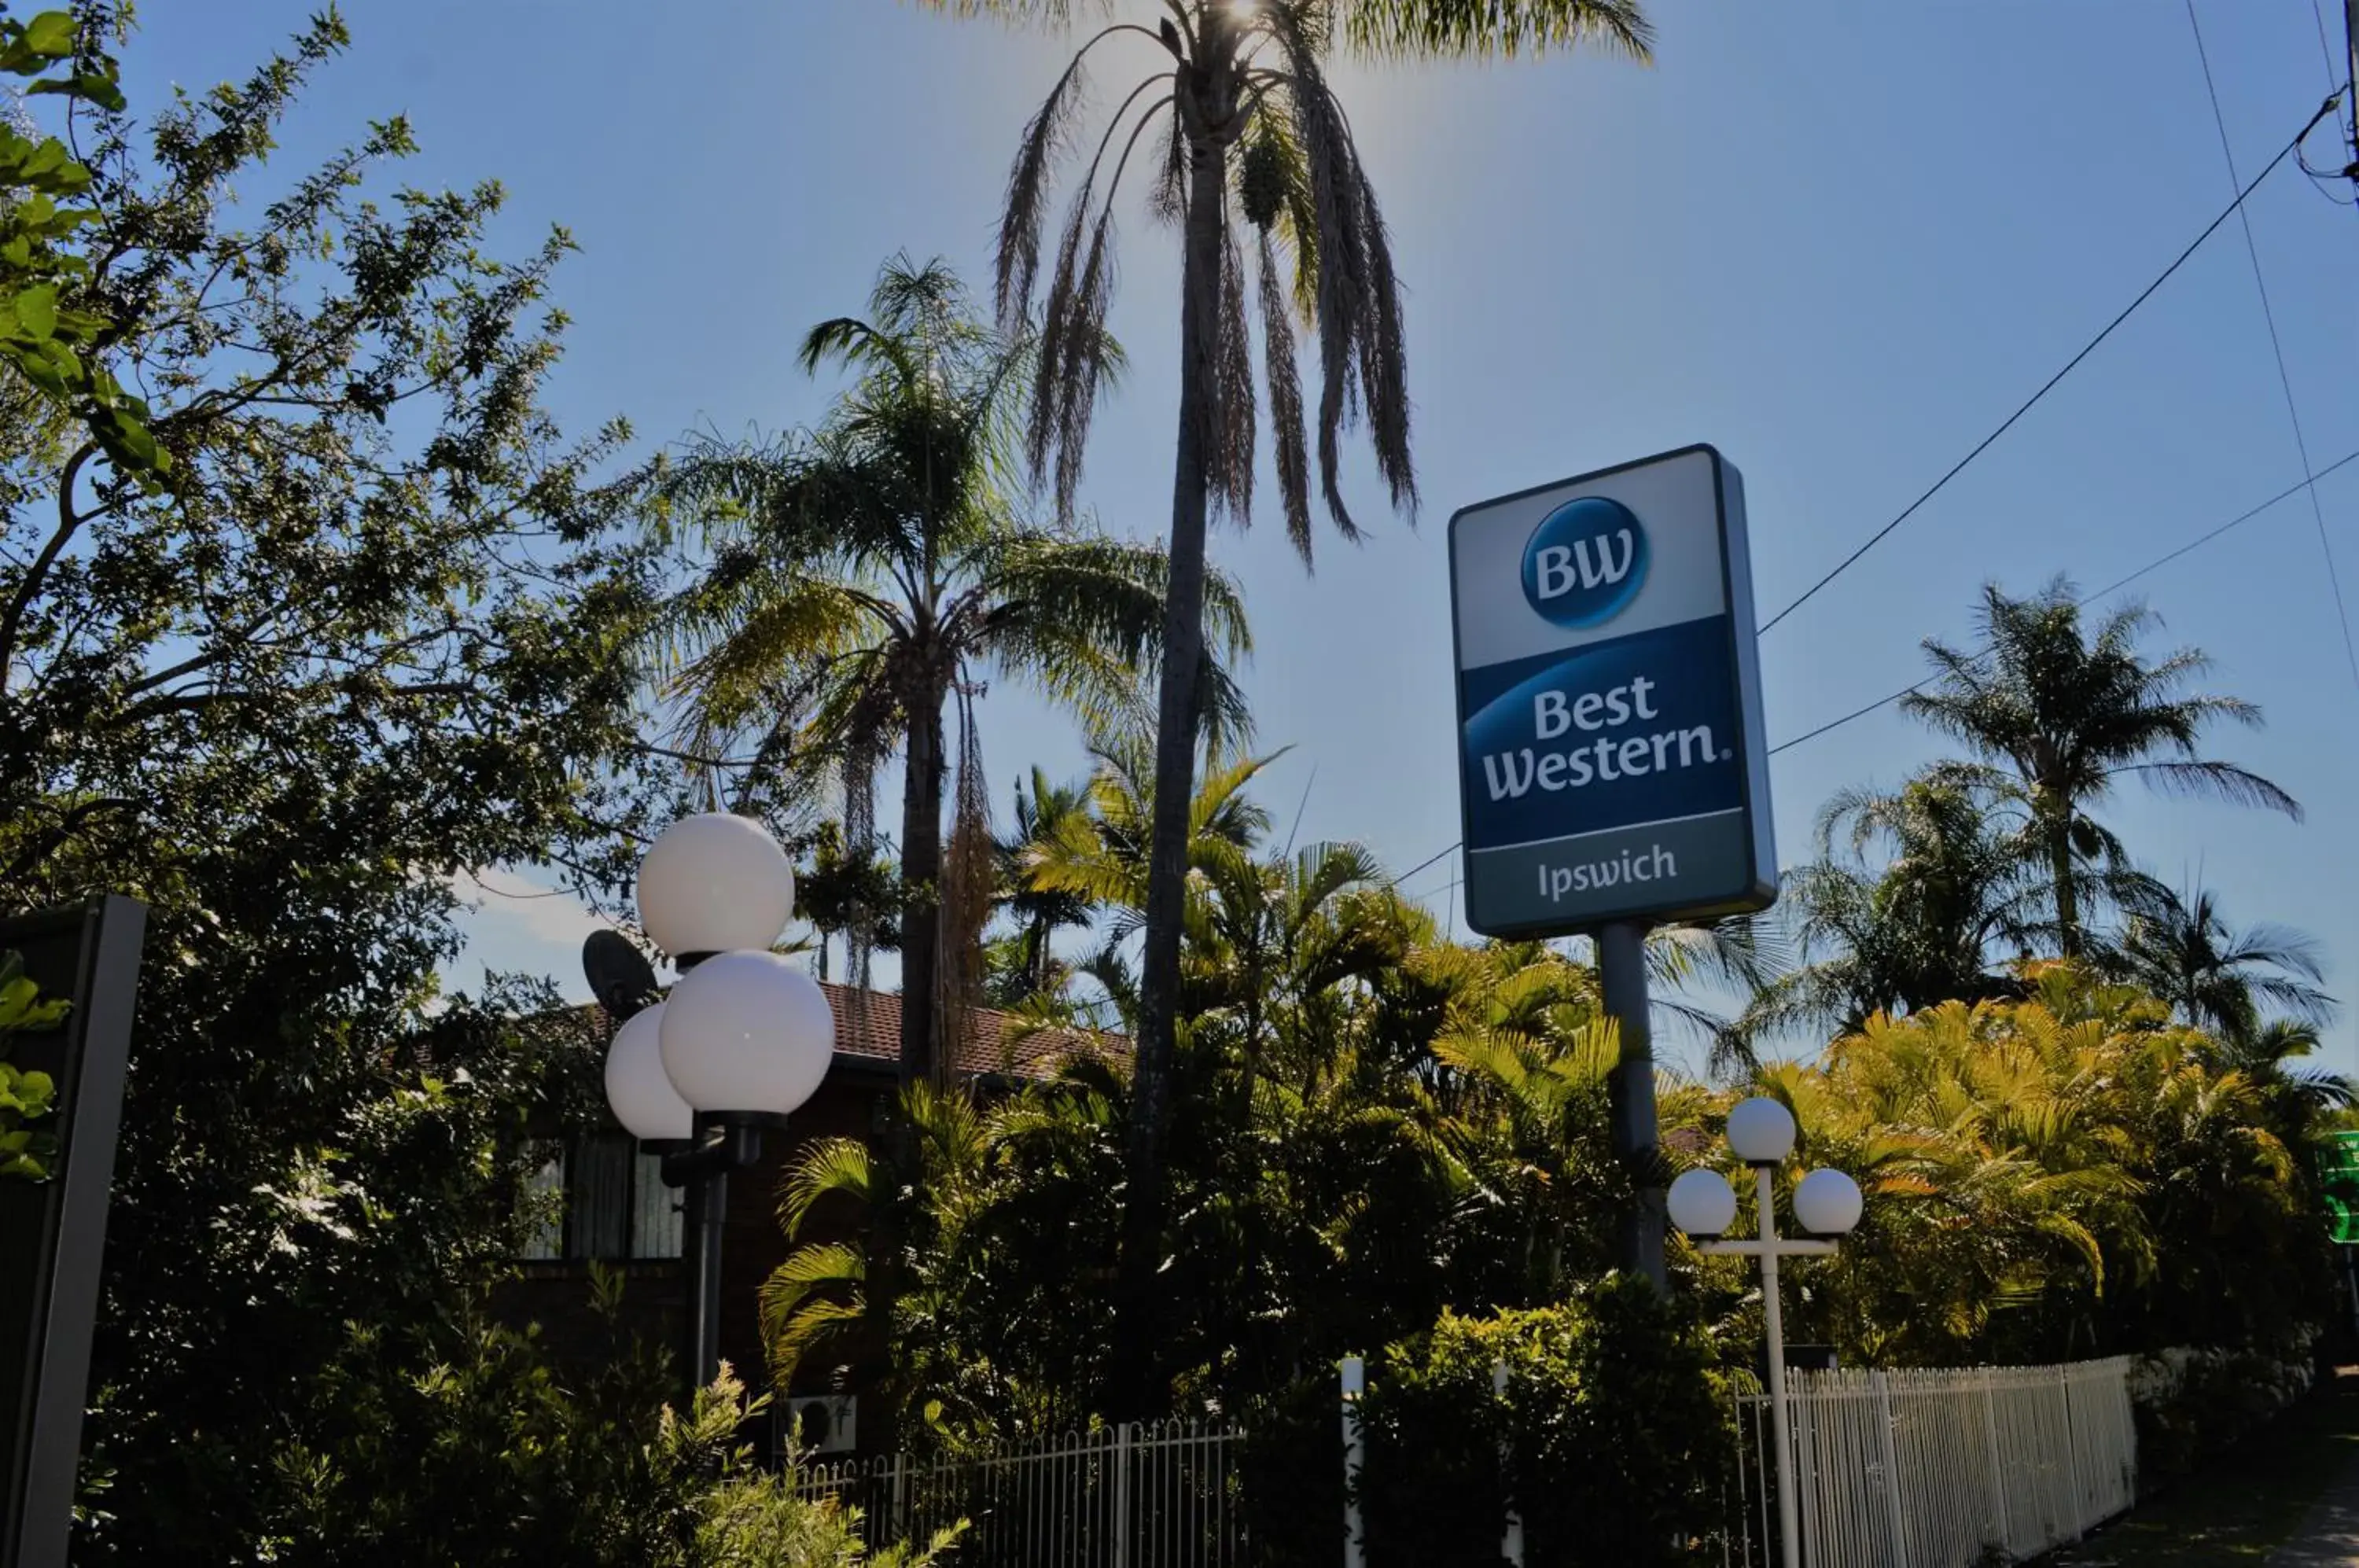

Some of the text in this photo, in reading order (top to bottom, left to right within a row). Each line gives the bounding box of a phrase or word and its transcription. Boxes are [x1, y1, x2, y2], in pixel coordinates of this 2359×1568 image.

[1536, 528, 1633, 600] BW
[1534, 676, 1658, 740] Best
[1539, 845, 1676, 902] Ipswich
